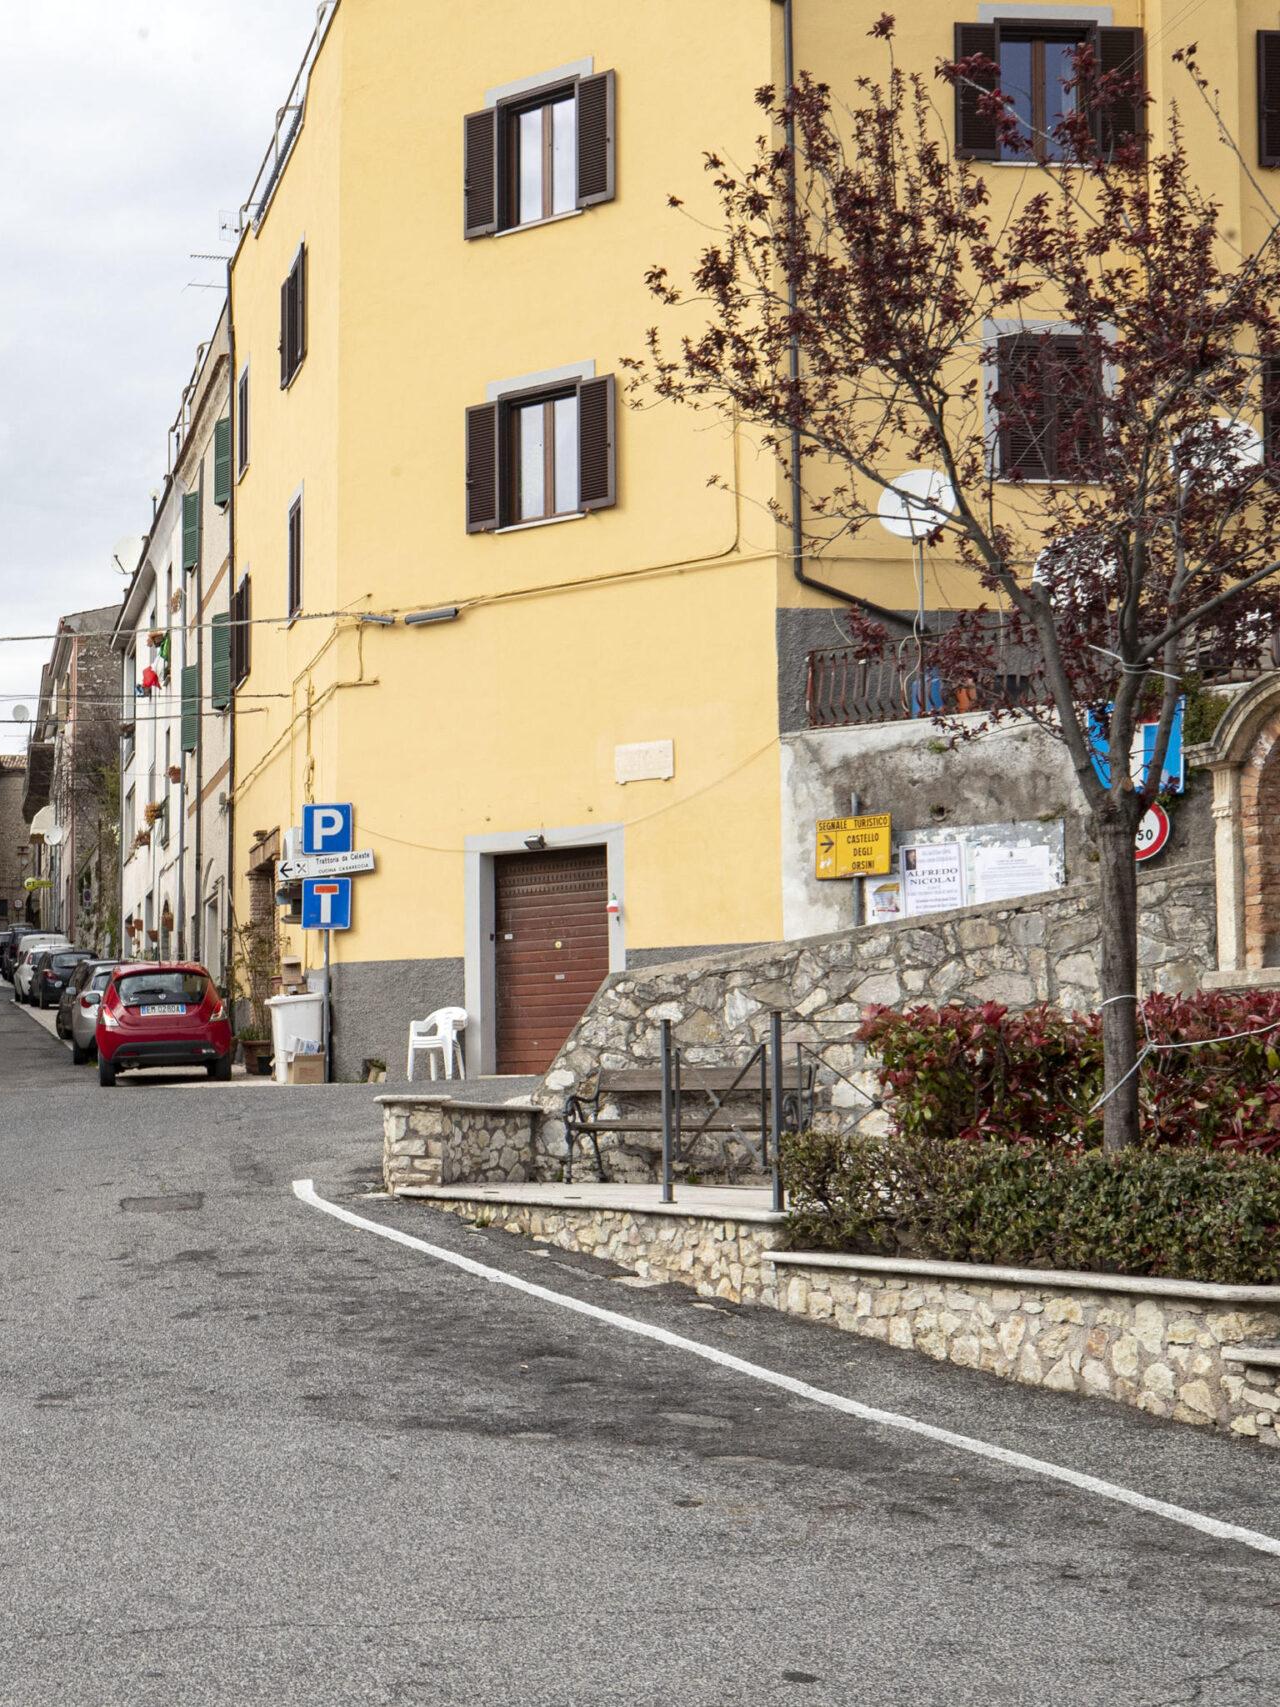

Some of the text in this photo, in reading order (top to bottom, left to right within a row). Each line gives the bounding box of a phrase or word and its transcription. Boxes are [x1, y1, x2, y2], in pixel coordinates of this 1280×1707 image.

[818, 816, 888, 831] SEGNALE TURISTICO
[313, 808, 344, 850] P
[846, 833, 880, 844] CASTELLO
[1136, 829, 1153, 840] 50
[853, 847, 873, 857] DEGLI
[316, 856, 339, 866] Trattoria
[350, 852, 370, 861] Celeste
[852, 860, 875, 870] ORSINI
[318, 867, 337, 875] CUCINA
[908, 867, 958, 877] ALFREDO
[910, 876, 956, 886] NICOLAI
